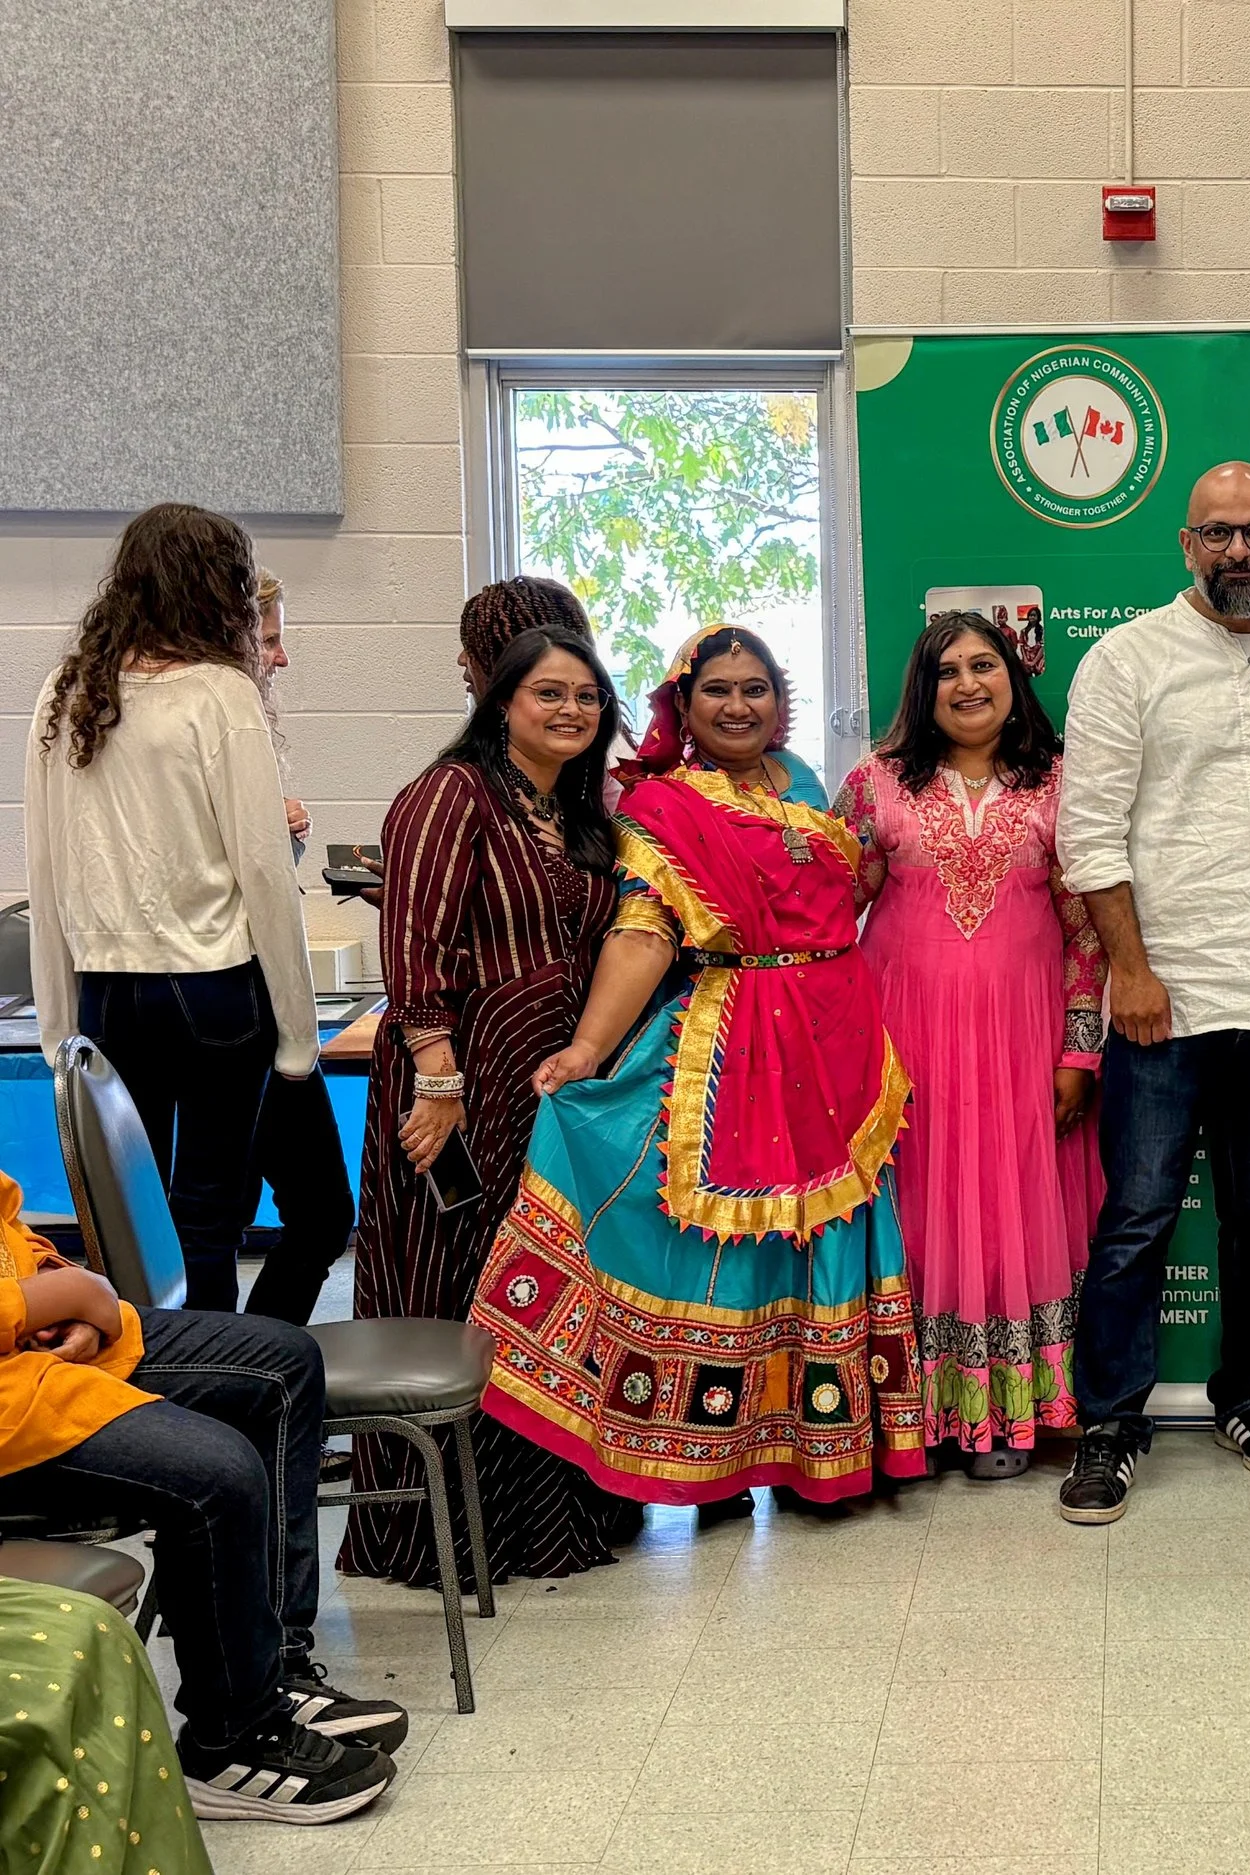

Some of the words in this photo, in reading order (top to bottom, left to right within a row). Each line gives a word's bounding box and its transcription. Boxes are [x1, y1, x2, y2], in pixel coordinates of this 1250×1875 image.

[1031, 357, 1090, 381] NIGERIAN
[1016, 380, 1031, 397] OF
[1093, 359, 1152, 416] COMMUNITY
[1143, 418, 1155, 432] IN
[1003, 398, 1026, 483] ASSOCIATION
[1134, 438, 1155, 483] MILTON
[1033, 493, 1081, 517] STRONGER
[1083, 492, 1128, 516] TOGETHER
[1050, 607, 1081, 619] Arts
[1084, 607, 1107, 619] For
[1111, 607, 1121, 619] A
[1160, 1309, 1209, 1325] MENT
